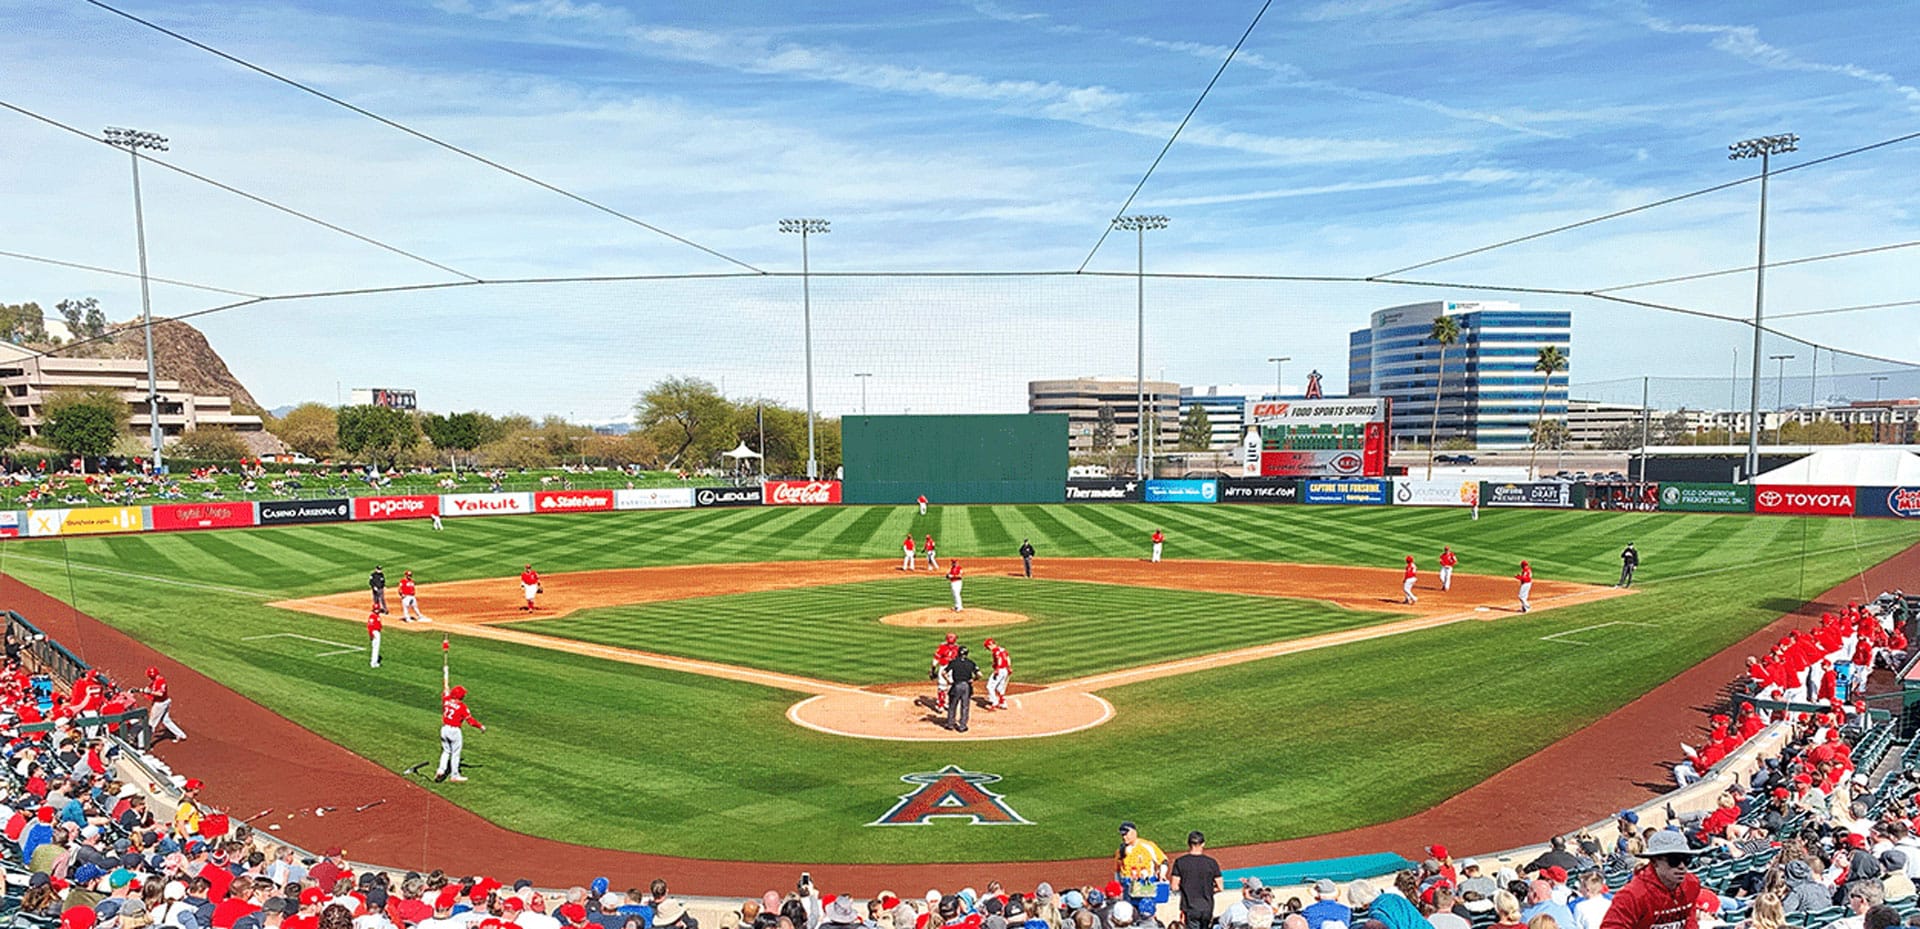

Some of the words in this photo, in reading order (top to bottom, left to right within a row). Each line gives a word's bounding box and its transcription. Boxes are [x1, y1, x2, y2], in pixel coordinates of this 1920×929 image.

[1313, 406, 1345, 417] SPORTS
[1345, 405, 1378, 416] SPIRITS
[715, 492, 760, 501] LEXUS
[1066, 487, 1126, 498] Thermador
[1225, 486, 1253, 497] NITTO
[454, 498, 520, 511] Yakult
[1785, 493, 1852, 507] TOYOTA
[369, 498, 425, 517] popchips
[862, 764, 1039, 827] A
